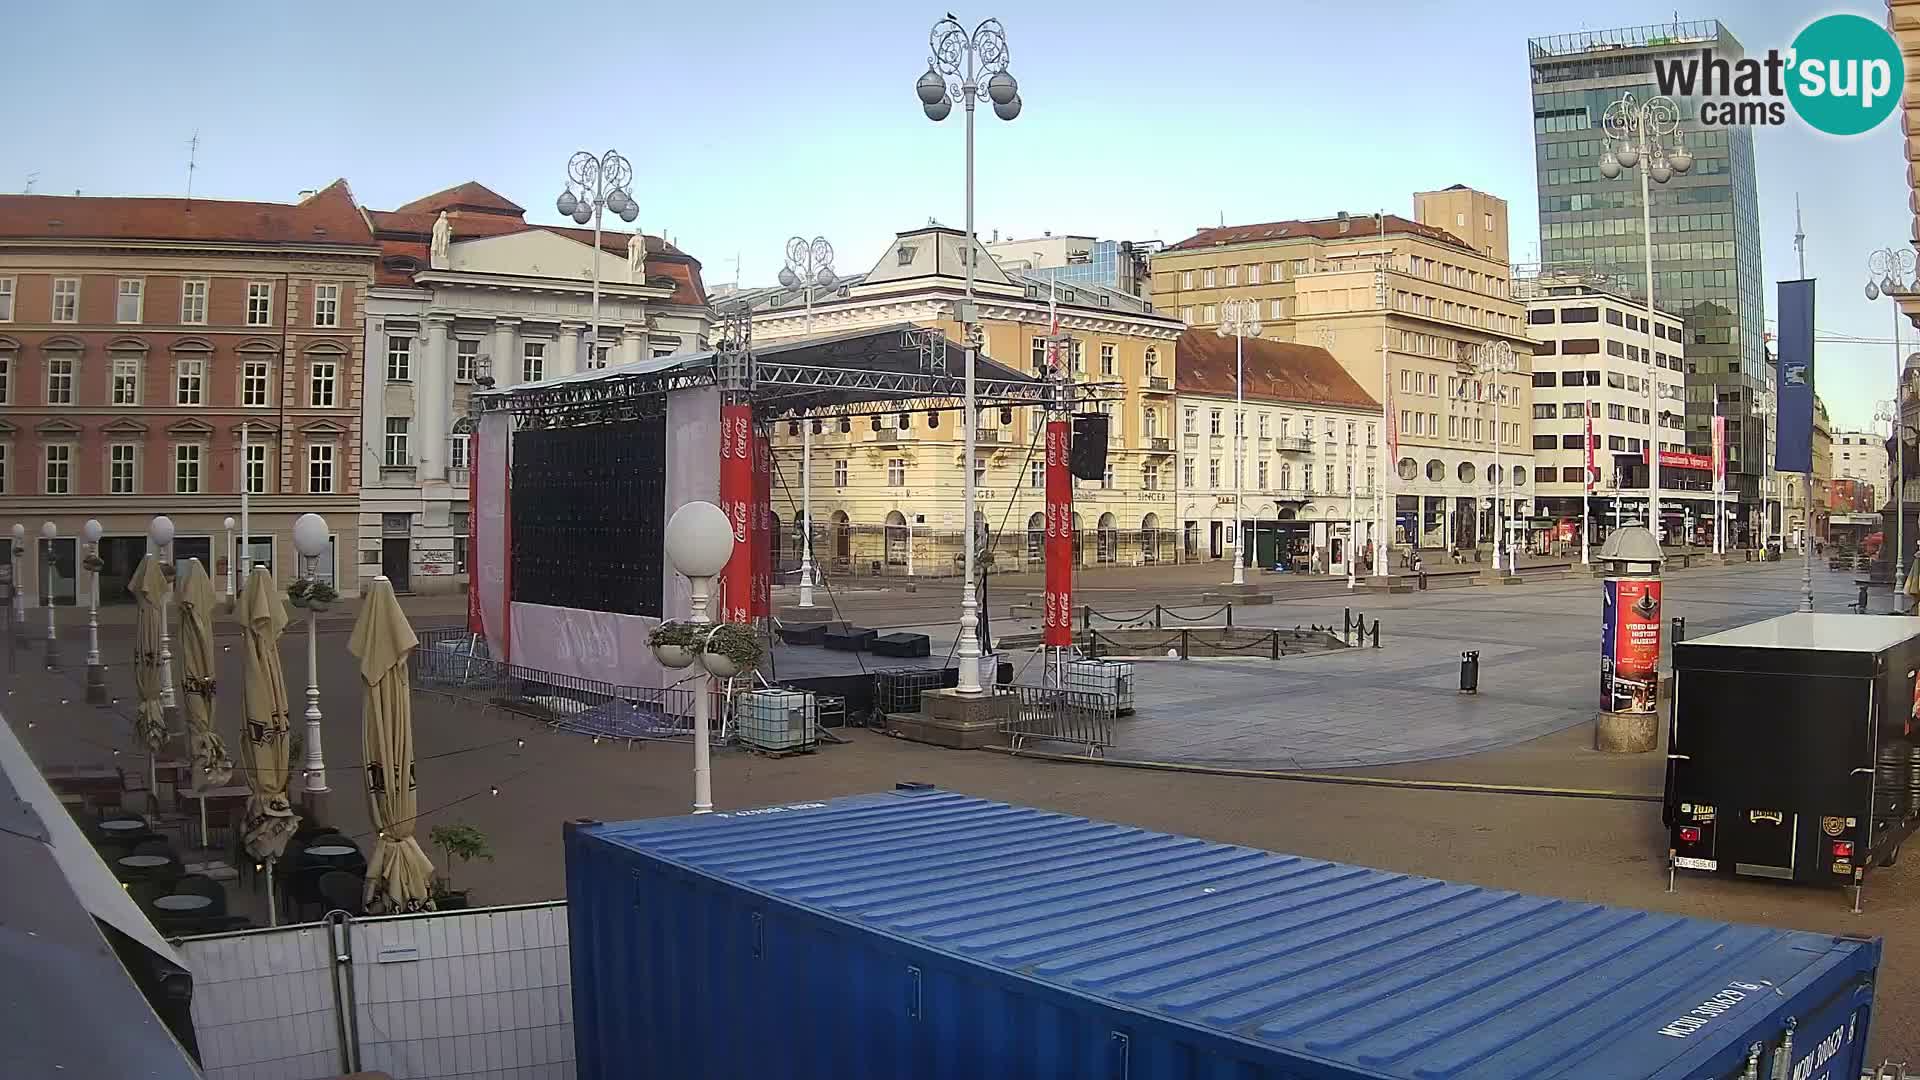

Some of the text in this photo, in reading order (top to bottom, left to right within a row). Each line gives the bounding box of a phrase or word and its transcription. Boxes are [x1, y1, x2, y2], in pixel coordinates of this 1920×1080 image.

[1138, 492, 1166, 501] SINGER
[1657, 1015, 1709, 1038] MCDU
[1690, 989, 1747, 1018] 300629
[1814, 1025, 1844, 1070] 300629
